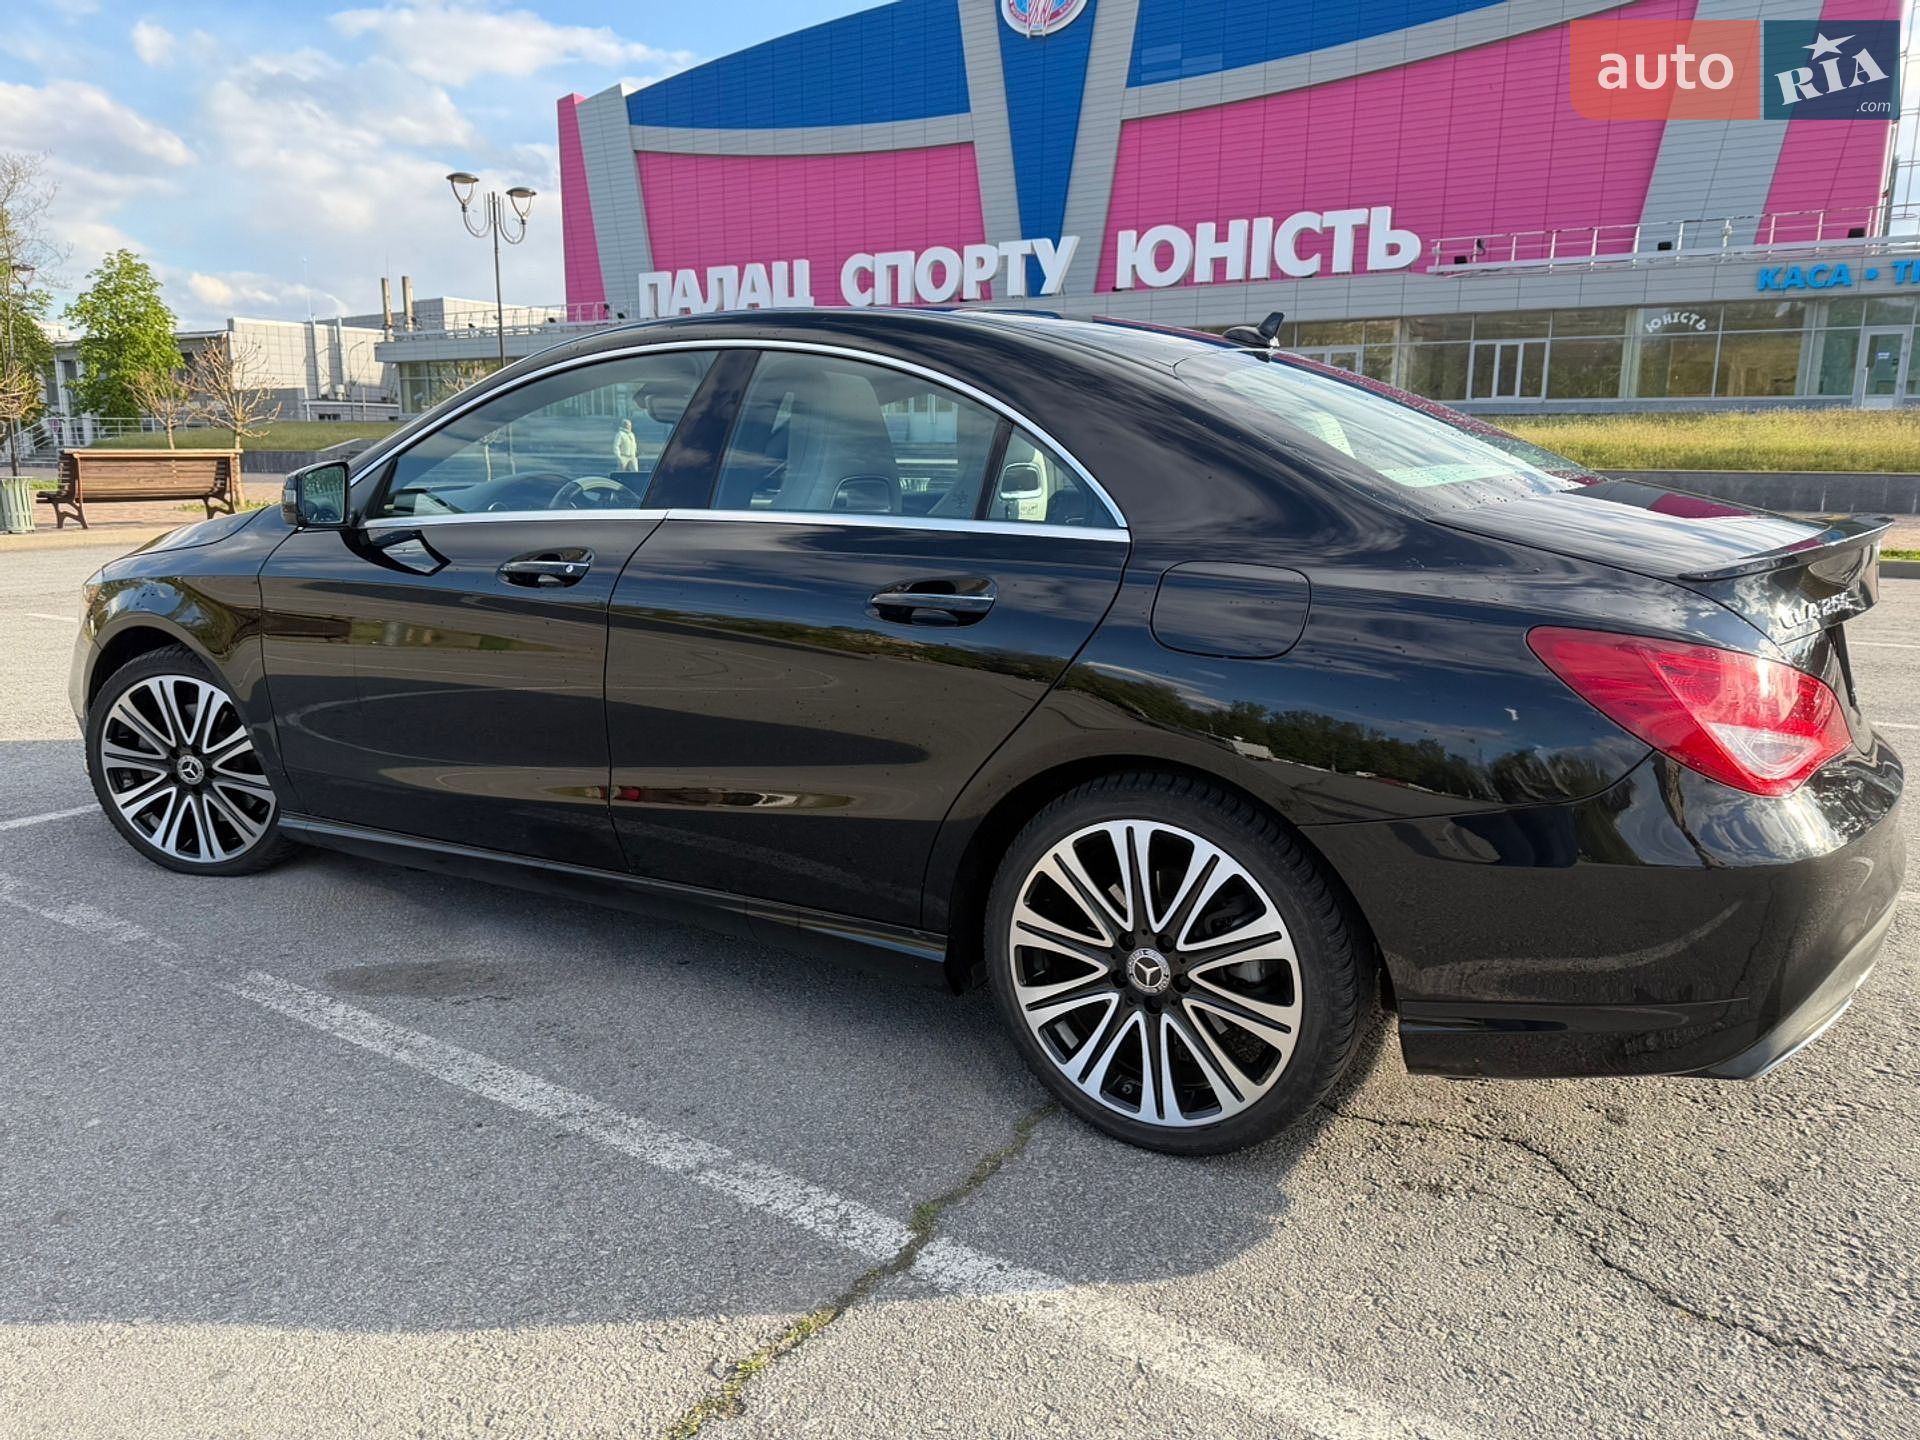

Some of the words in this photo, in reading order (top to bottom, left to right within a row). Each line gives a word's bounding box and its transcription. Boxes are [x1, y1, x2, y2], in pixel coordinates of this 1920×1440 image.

[638, 258, 815, 319] ПАЛАЦ
[840, 235, 1080, 306] СПОРТУ
[1115, 206, 1422, 289] ЮНІСТЬ
[1757, 262, 1853, 291] КАСА
[1645, 311, 1707, 334] ЮНІСТЬ
